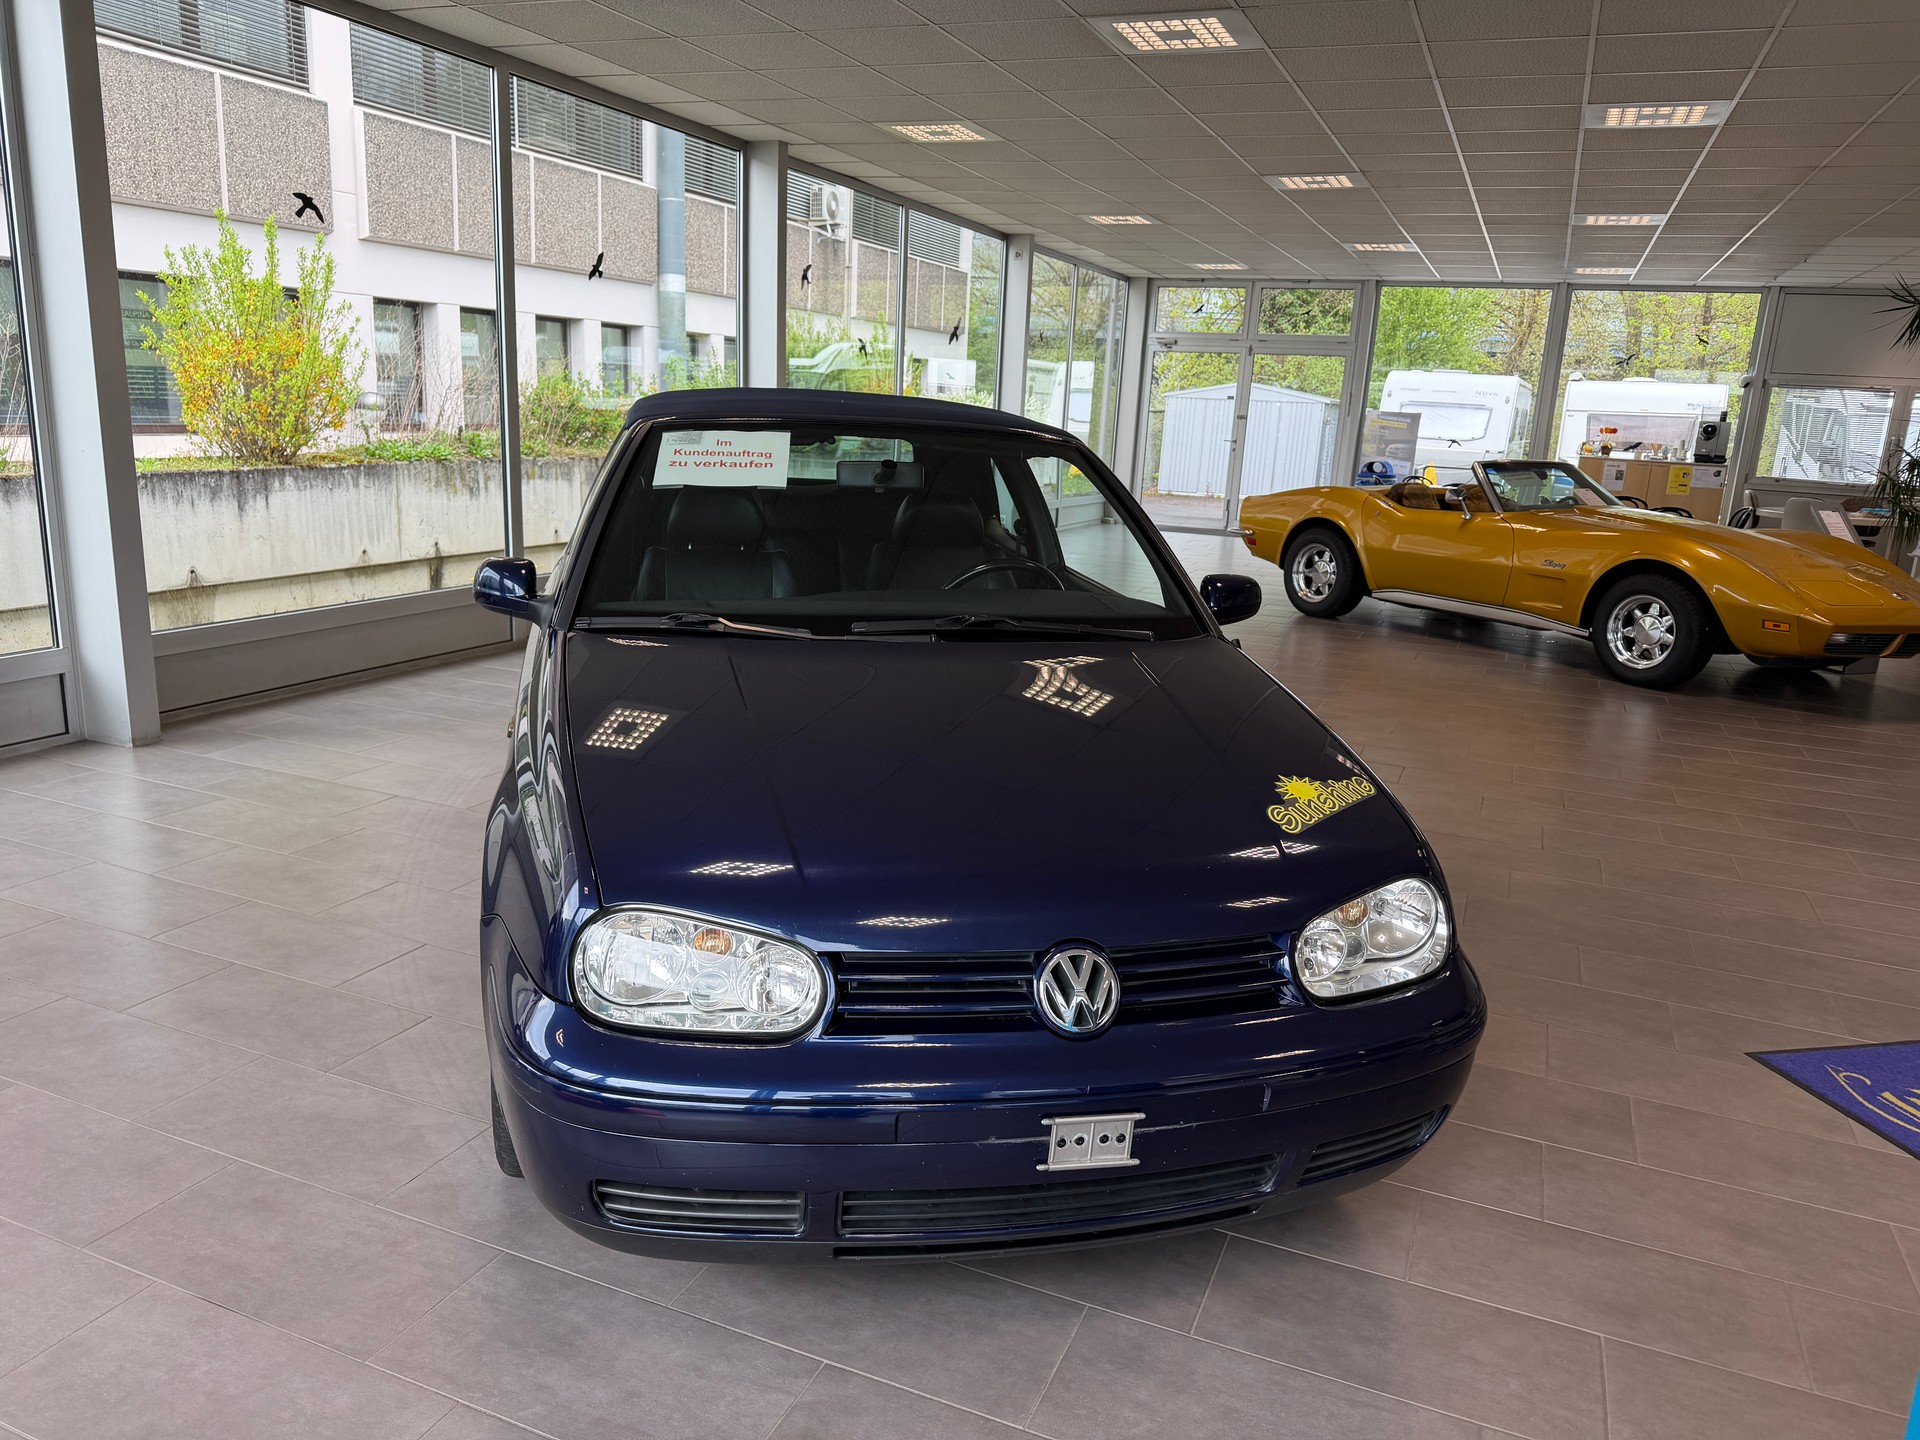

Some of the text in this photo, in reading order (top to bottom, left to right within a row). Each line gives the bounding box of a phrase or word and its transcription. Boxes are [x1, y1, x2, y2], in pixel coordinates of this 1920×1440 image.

[716, 438, 732, 447] Im
[673, 448, 773, 459] Kundenauftrag
[668, 459, 774, 469] zu verkaufen
[1267, 776, 1375, 834] Sunshine
[1041, 949, 1116, 1032] VW
